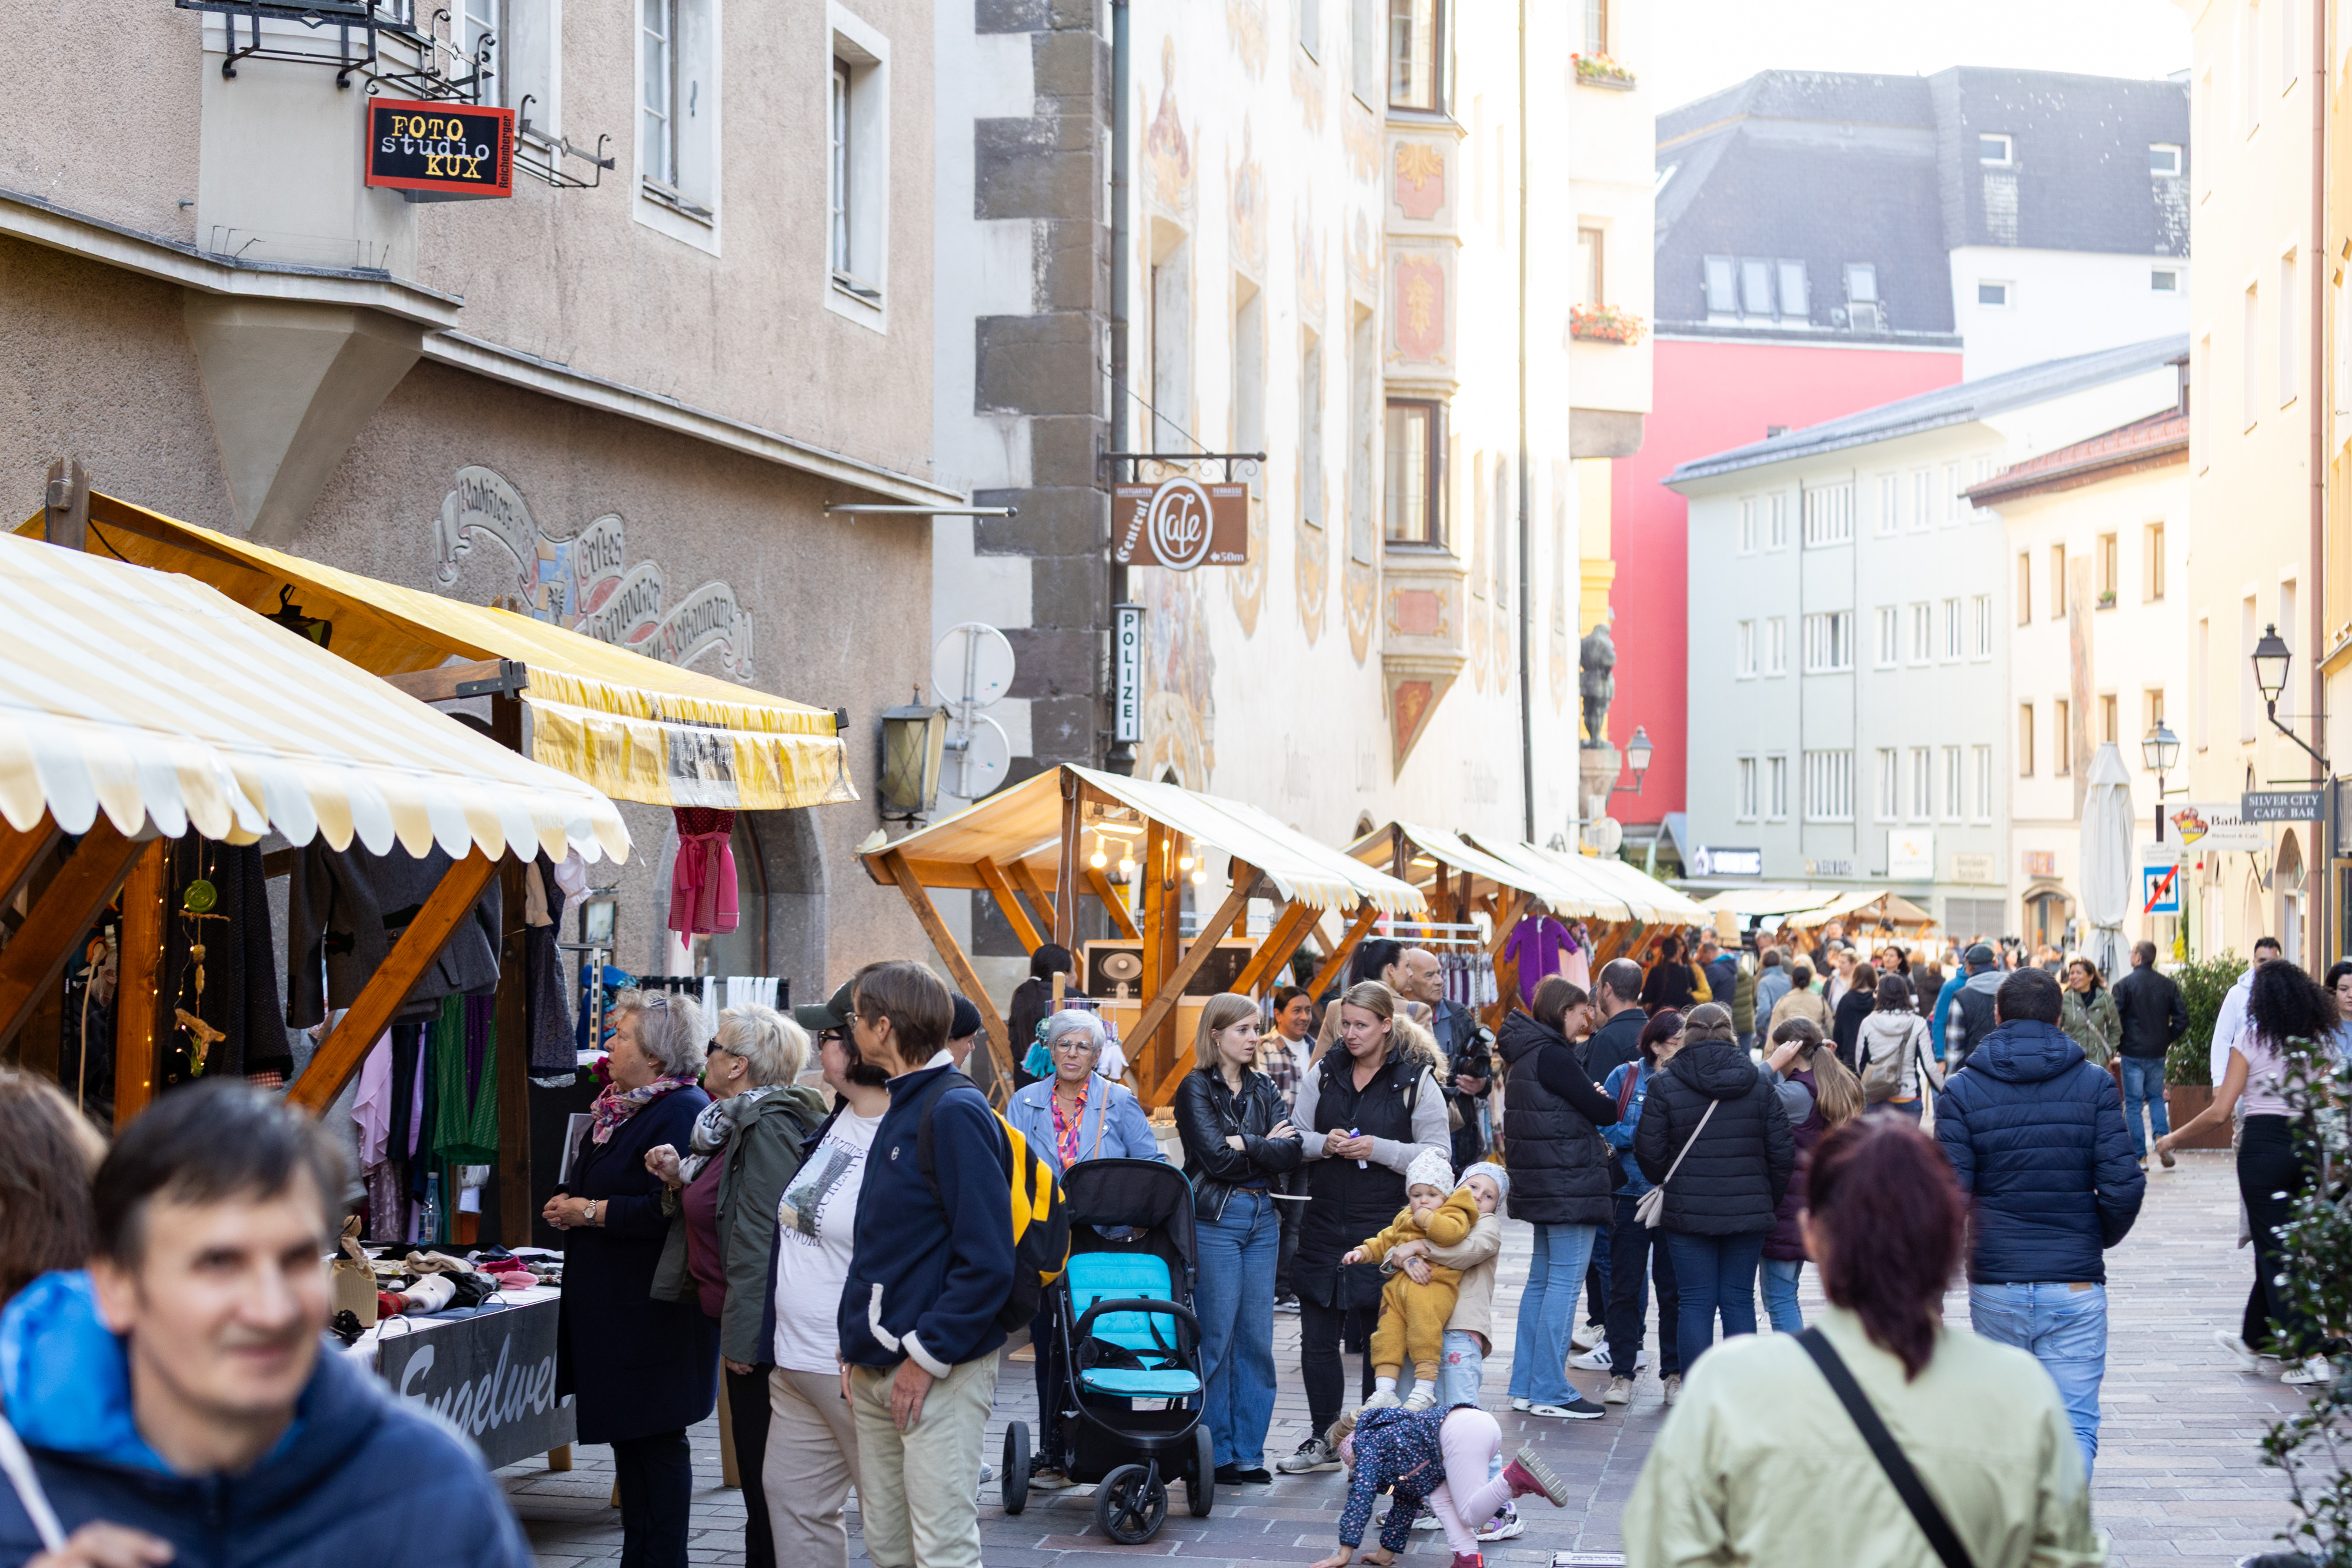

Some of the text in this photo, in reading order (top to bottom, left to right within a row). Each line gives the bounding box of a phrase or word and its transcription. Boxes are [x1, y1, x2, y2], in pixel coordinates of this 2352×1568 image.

[391, 115, 464, 141] FOTO
[381, 133, 490, 161] studio
[498, 115, 512, 189] Reichenberger
[425, 154, 482, 179] KUX
[1117, 487, 1153, 495] GASTGARTEN
[1116, 499, 1150, 563] Central
[1220, 551, 1244, 562] 50m
[1123, 614, 1134, 736] POLIZEI
[2249, 794, 2318, 807] SILVER CITY
[2254, 807, 2315, 818] CAFE BAR
[399, 1332, 572, 1442] Engelwe
